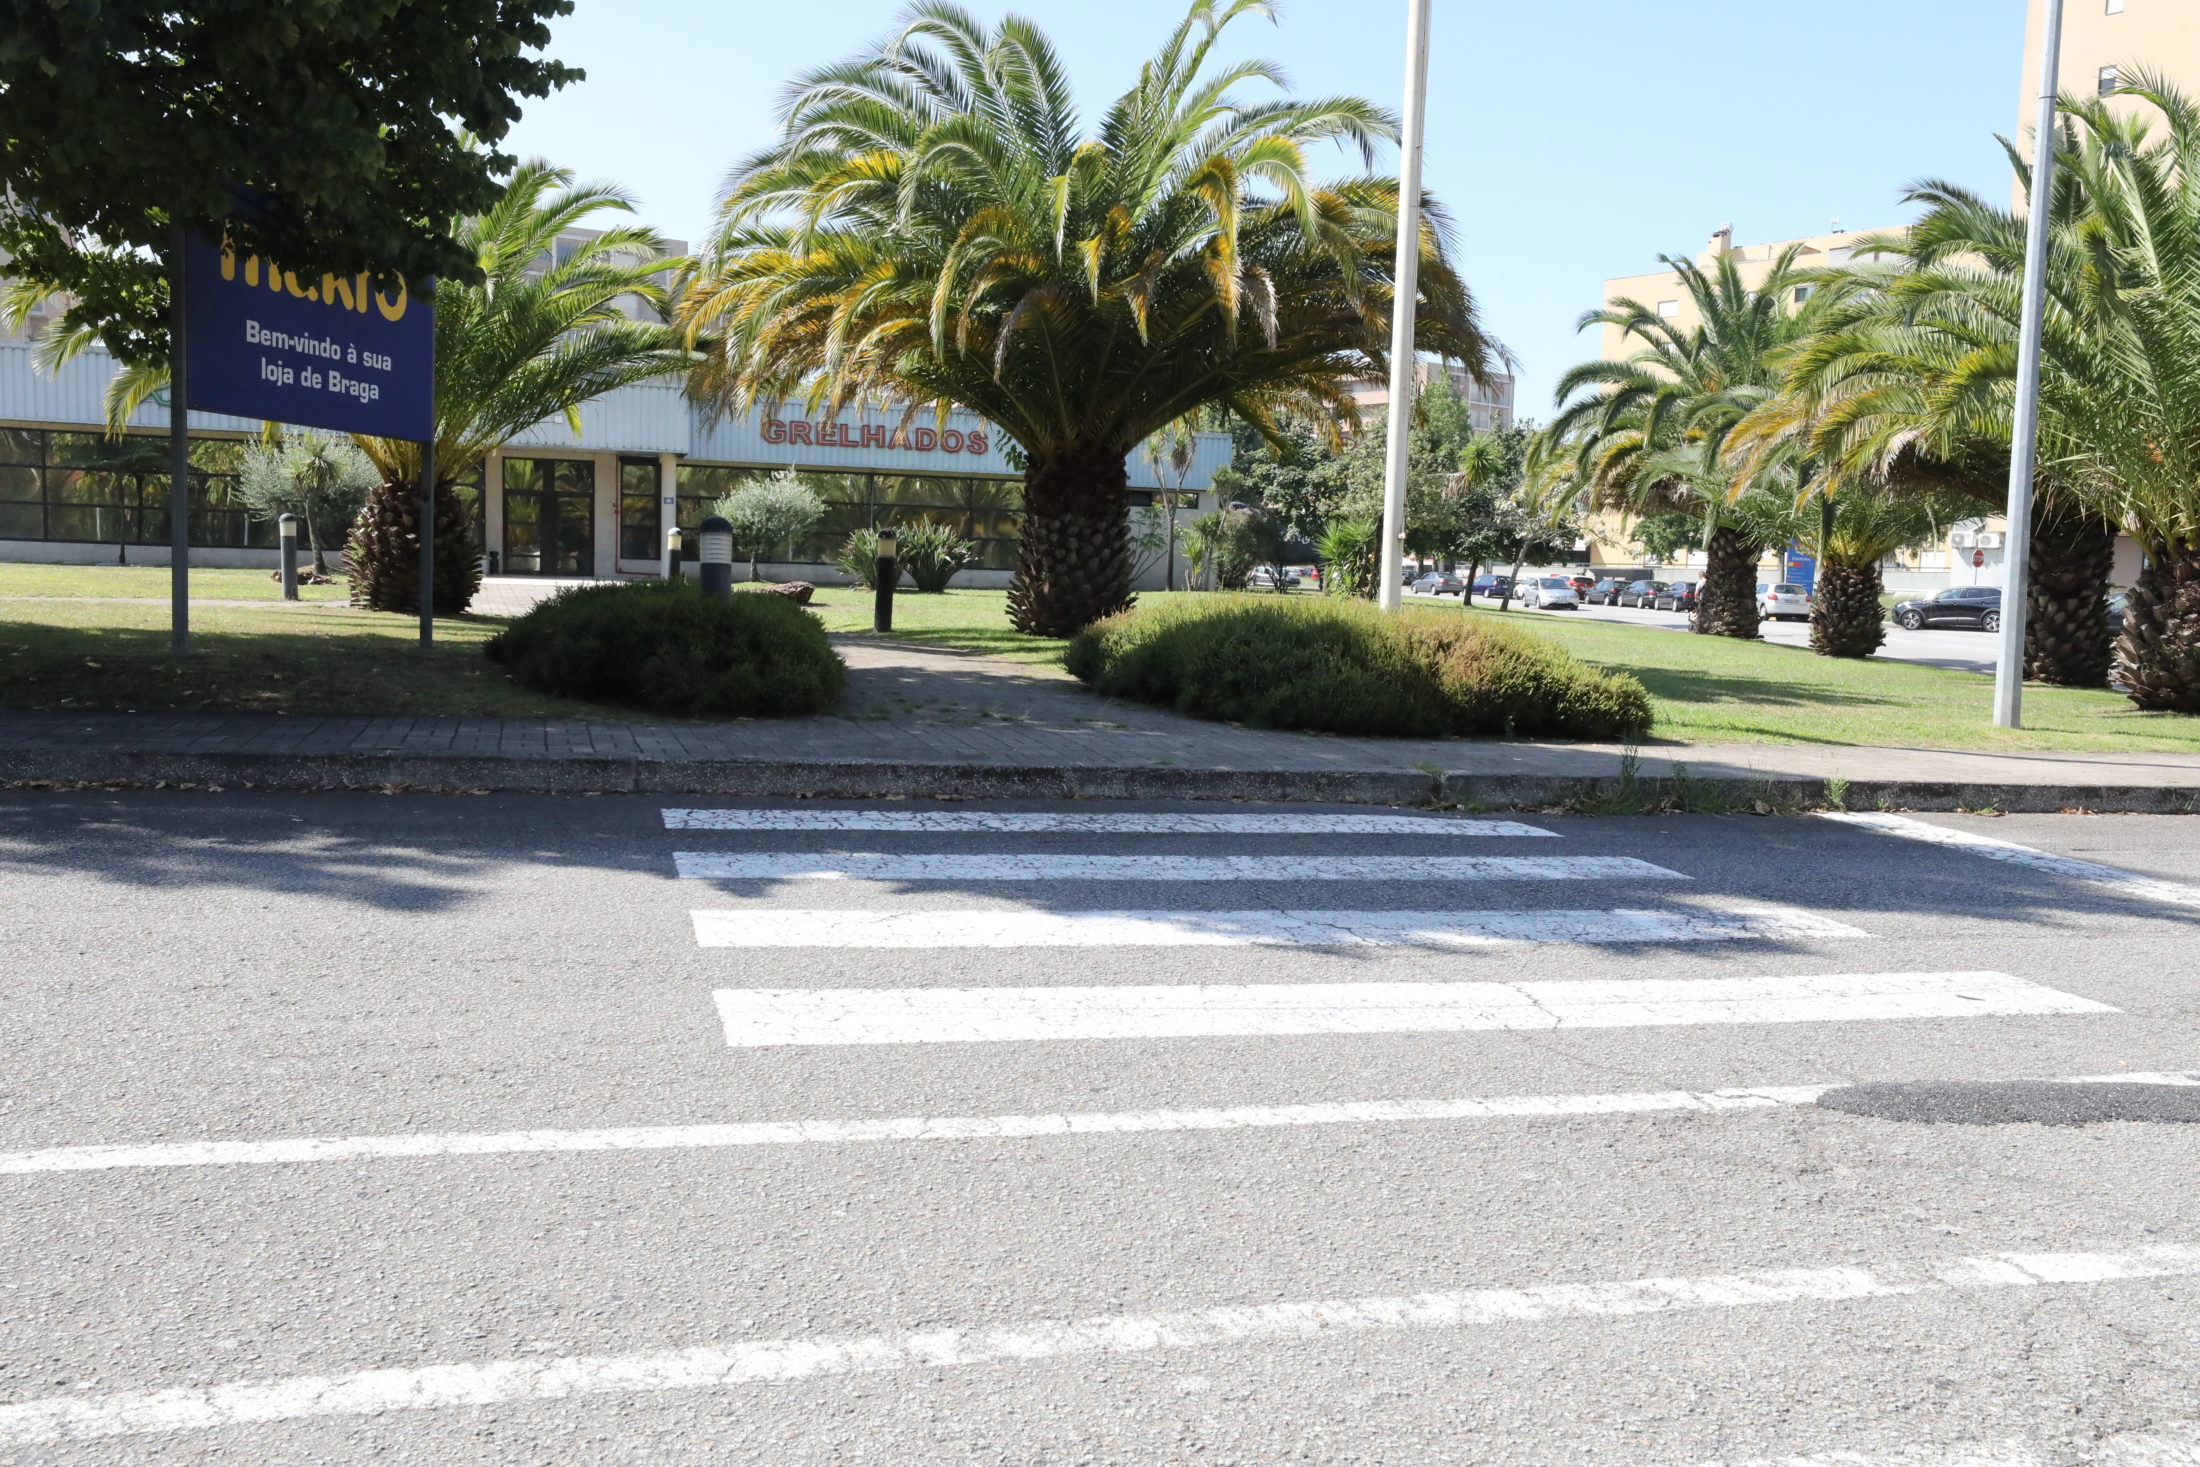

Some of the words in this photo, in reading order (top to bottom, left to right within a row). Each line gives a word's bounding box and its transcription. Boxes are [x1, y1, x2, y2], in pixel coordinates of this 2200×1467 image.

[246, 319, 341, 360] Bem-vindo
[347, 343, 357, 364] à
[363, 351, 392, 371] sua
[261, 357, 294, 386] loja
[301, 366, 322, 388] de
[328, 370, 379, 403] Braga
[760, 419, 989, 455] GRELHADOS
